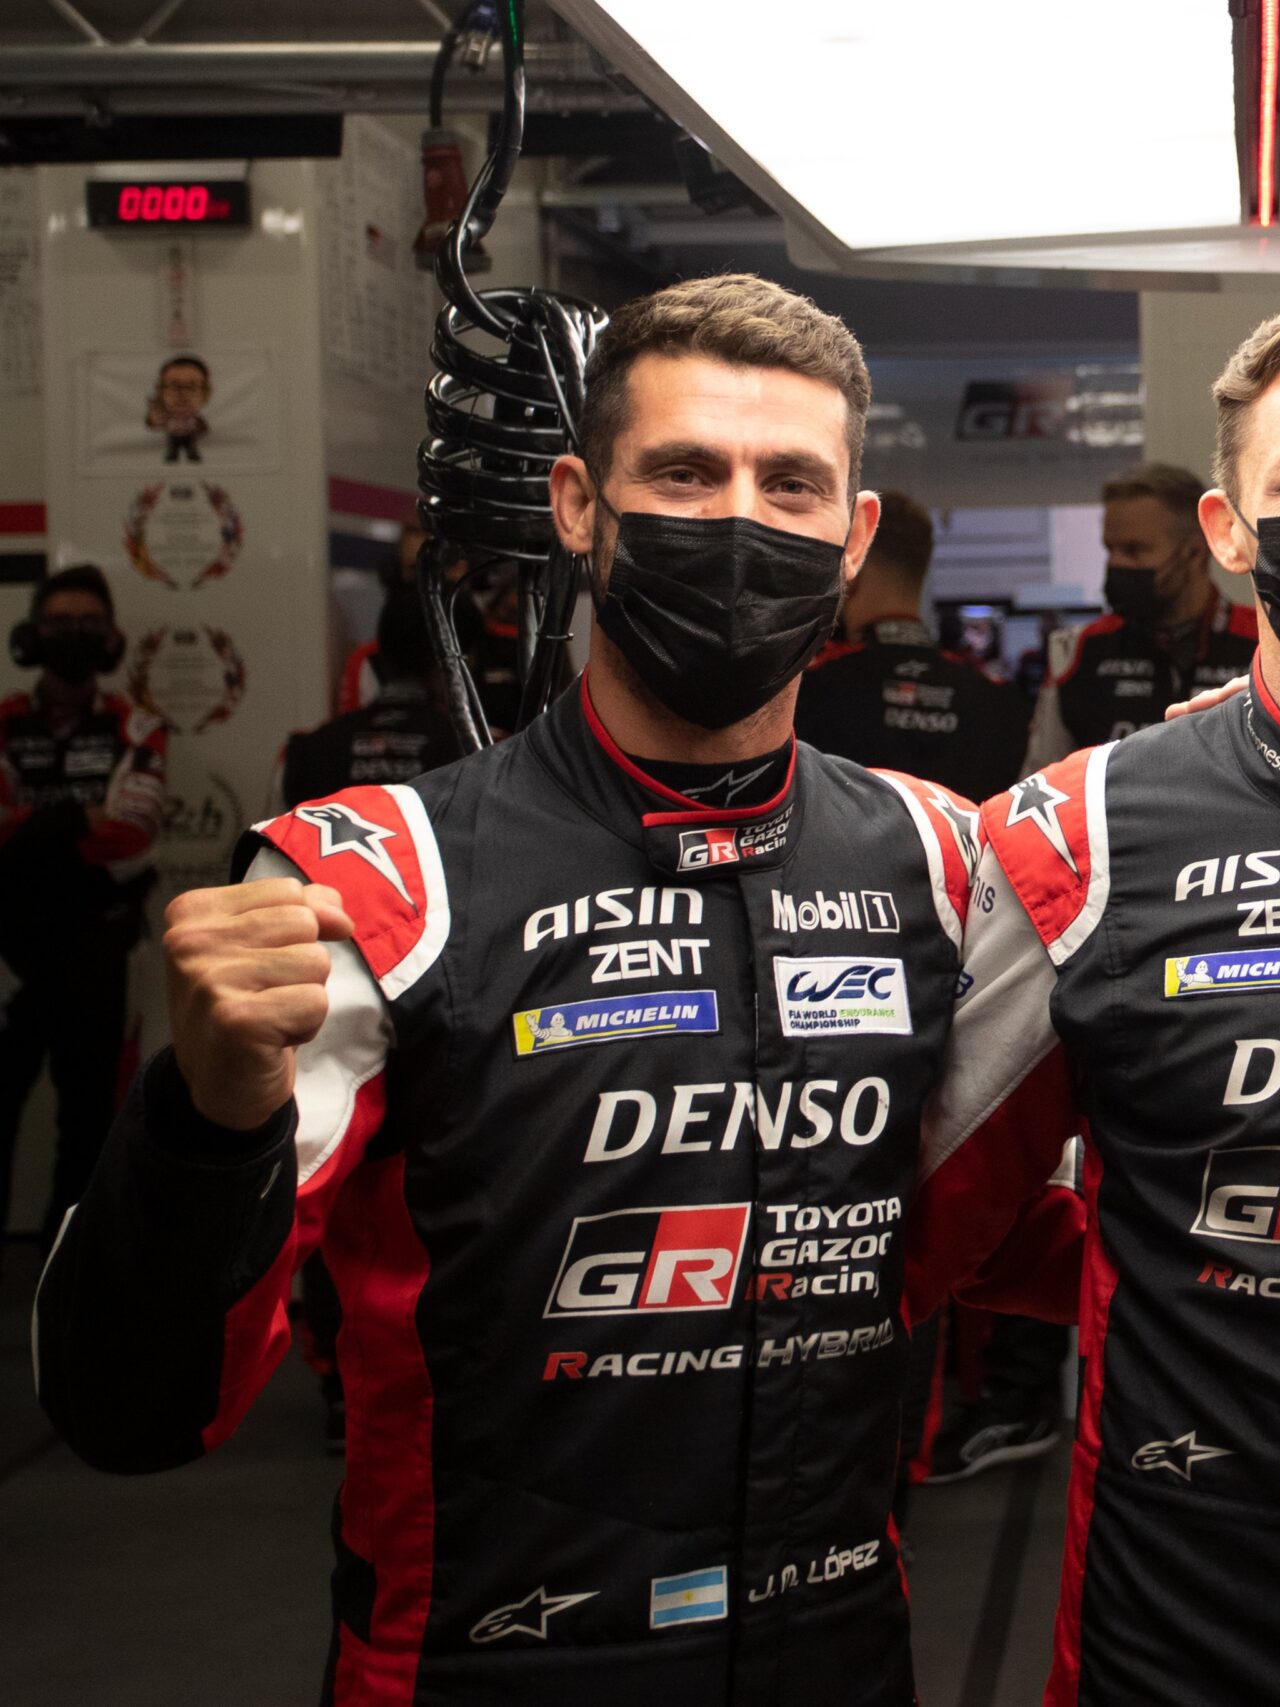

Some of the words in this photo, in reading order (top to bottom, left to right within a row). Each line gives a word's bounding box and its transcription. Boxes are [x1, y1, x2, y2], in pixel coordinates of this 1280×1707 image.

[682, 842, 738, 868] GR
[524, 887, 704, 952] AISIN
[772, 889, 860, 932] Mobil
[588, 938, 710, 984] ZENT
[787, 965, 896, 1002] WEC
[575, 1004, 699, 1031] MICHELIN
[789, 1010, 801, 1019] FIA
[803, 1009, 837, 1019] WORLD
[839, 1008, 896, 1018] ENDURANCE
[790, 1019, 861, 1030] CHAMPIONSHIP
[583, 1076, 890, 1163] DENSO
[766, 1197, 901, 1233] TOYOTA
[556, 1247, 733, 1309] GR
[542, 1345, 743, 1381] RACING
[758, 1317, 894, 1368] HYBRID
[807, 1539, 880, 1583] LÓPEZ
